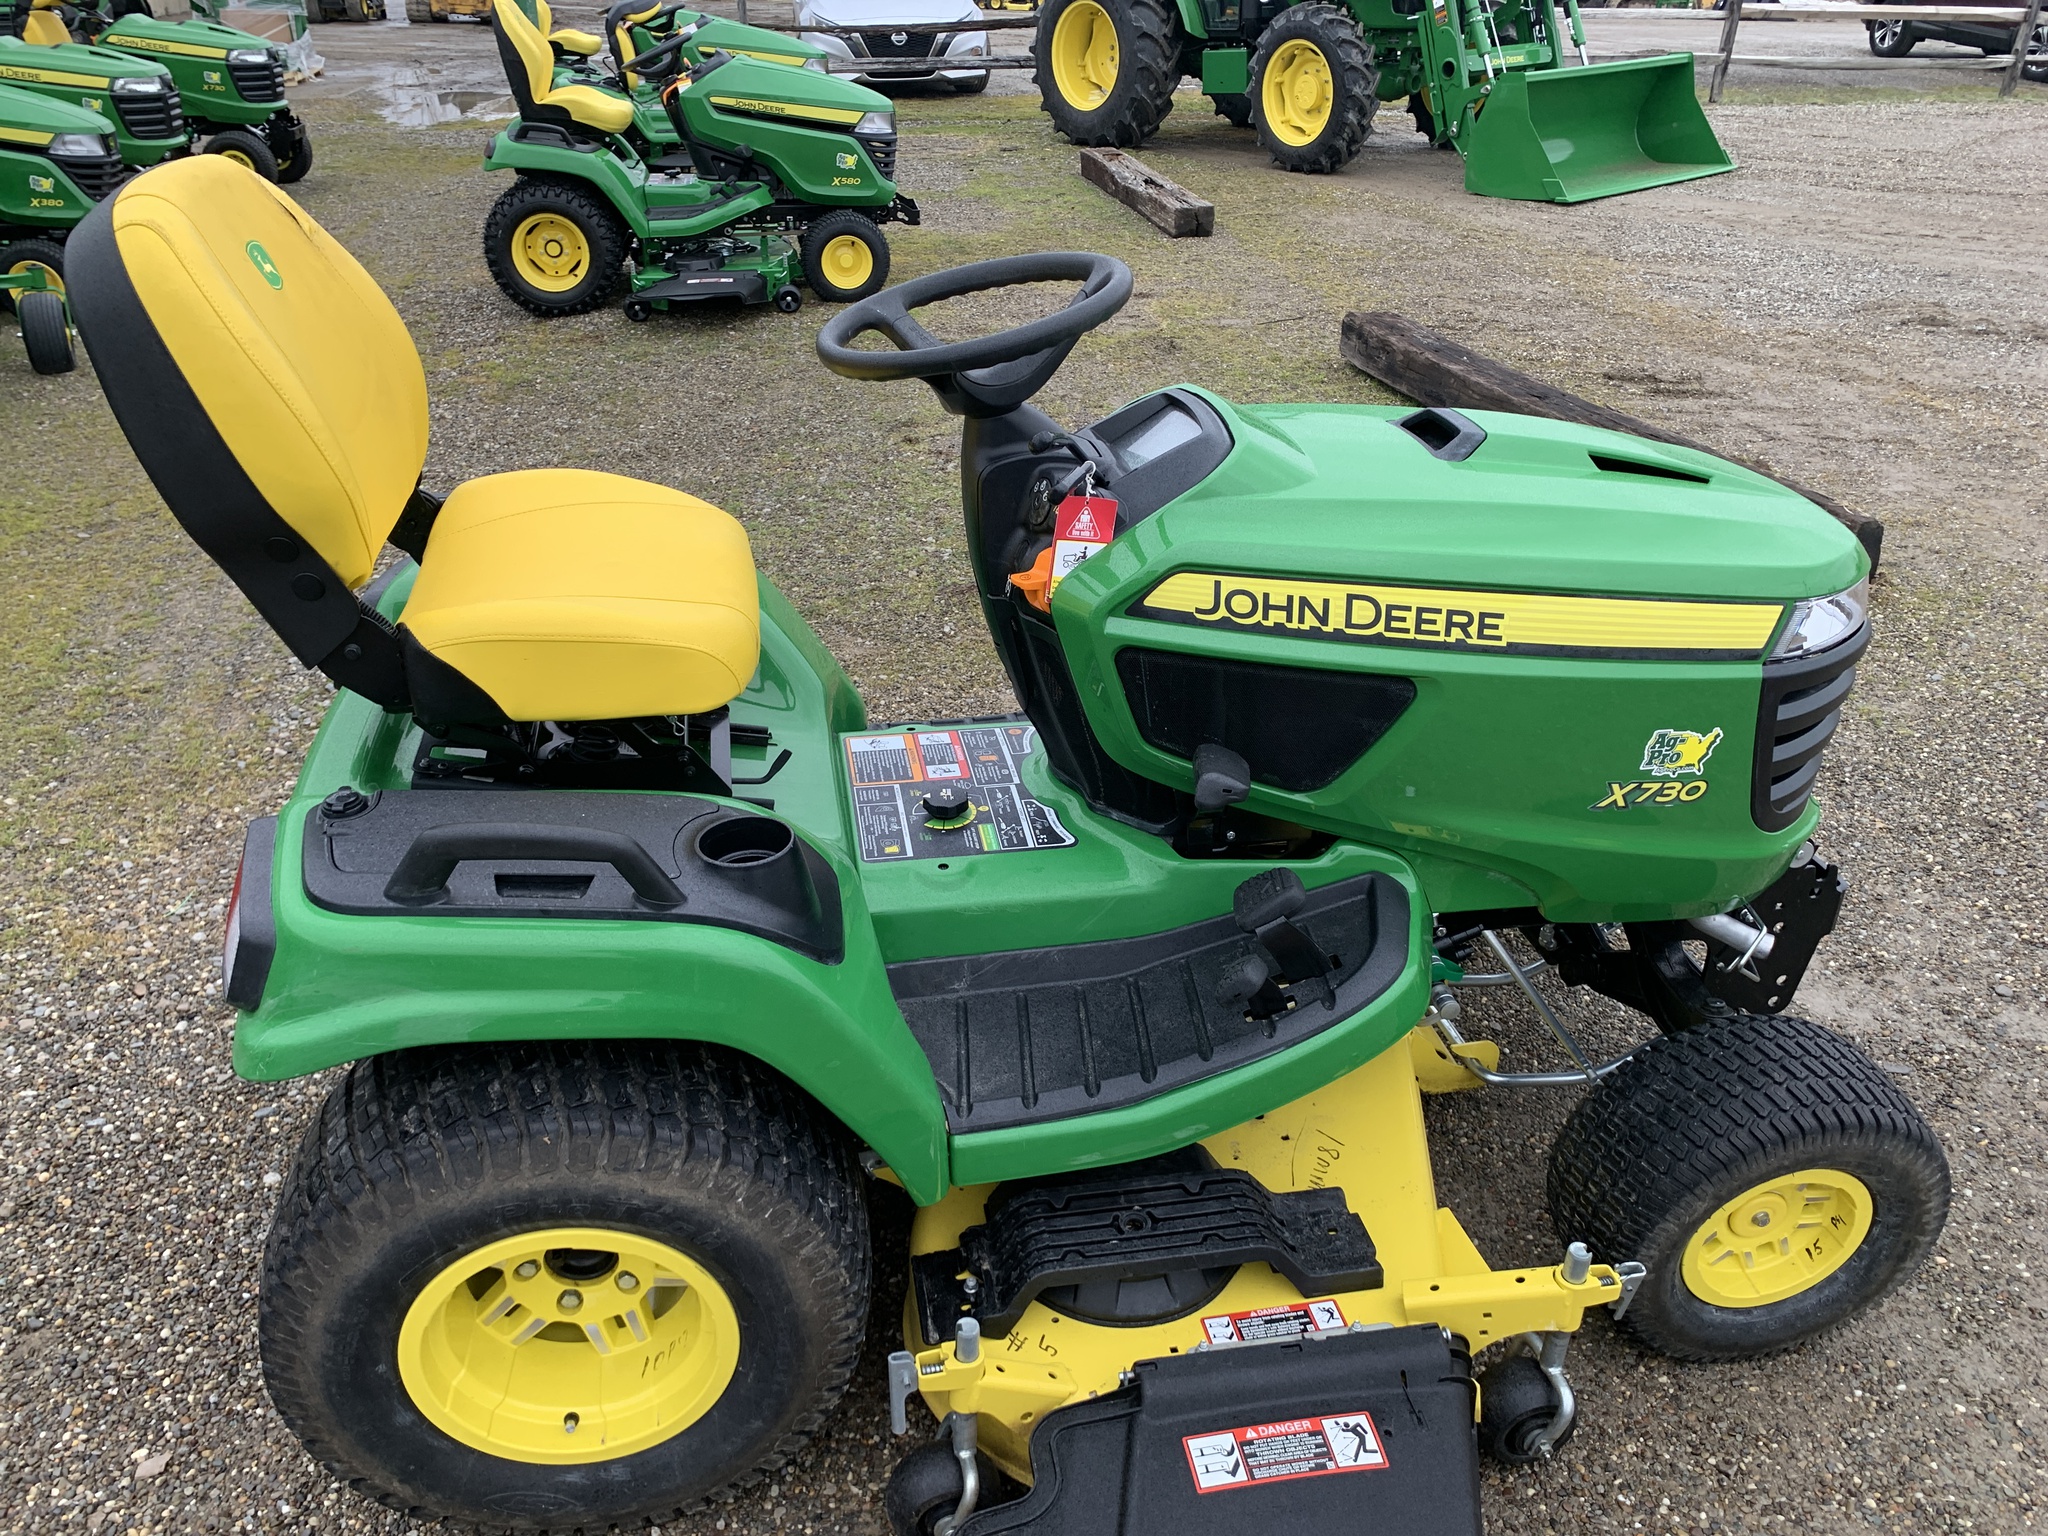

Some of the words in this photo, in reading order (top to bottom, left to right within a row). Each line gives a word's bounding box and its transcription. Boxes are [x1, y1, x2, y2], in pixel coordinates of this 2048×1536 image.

[114, 36, 139, 47] JOHN
[140, 40, 170, 51] DEERE
[1507, 55, 1524, 63] DEERE
[6, 68, 41, 80] DEERE
[733, 99, 757, 110] JOHN
[757, 102, 786, 114] DEERE
[831, 176, 861, 187] X580
[30, 197, 64, 208] X380
[1075, 521, 1093, 530] SAFETY
[1194, 579, 1330, 628] JOHN
[1344, 592, 1505, 641] DEERE
[1645, 750, 1682, 766] Pro
[1594, 780, 1709, 809] X730
[1805, 1237, 1822, 1262] 15
[1257, 1306, 1290, 1316] DANGER
[1258, 1420, 1312, 1435] DANGER
[1253, 1436, 1287, 1445] ROTATING
[1256, 1449, 1285, 1457] THROWN
[1286, 1444, 1316, 1453] OBJECTS
